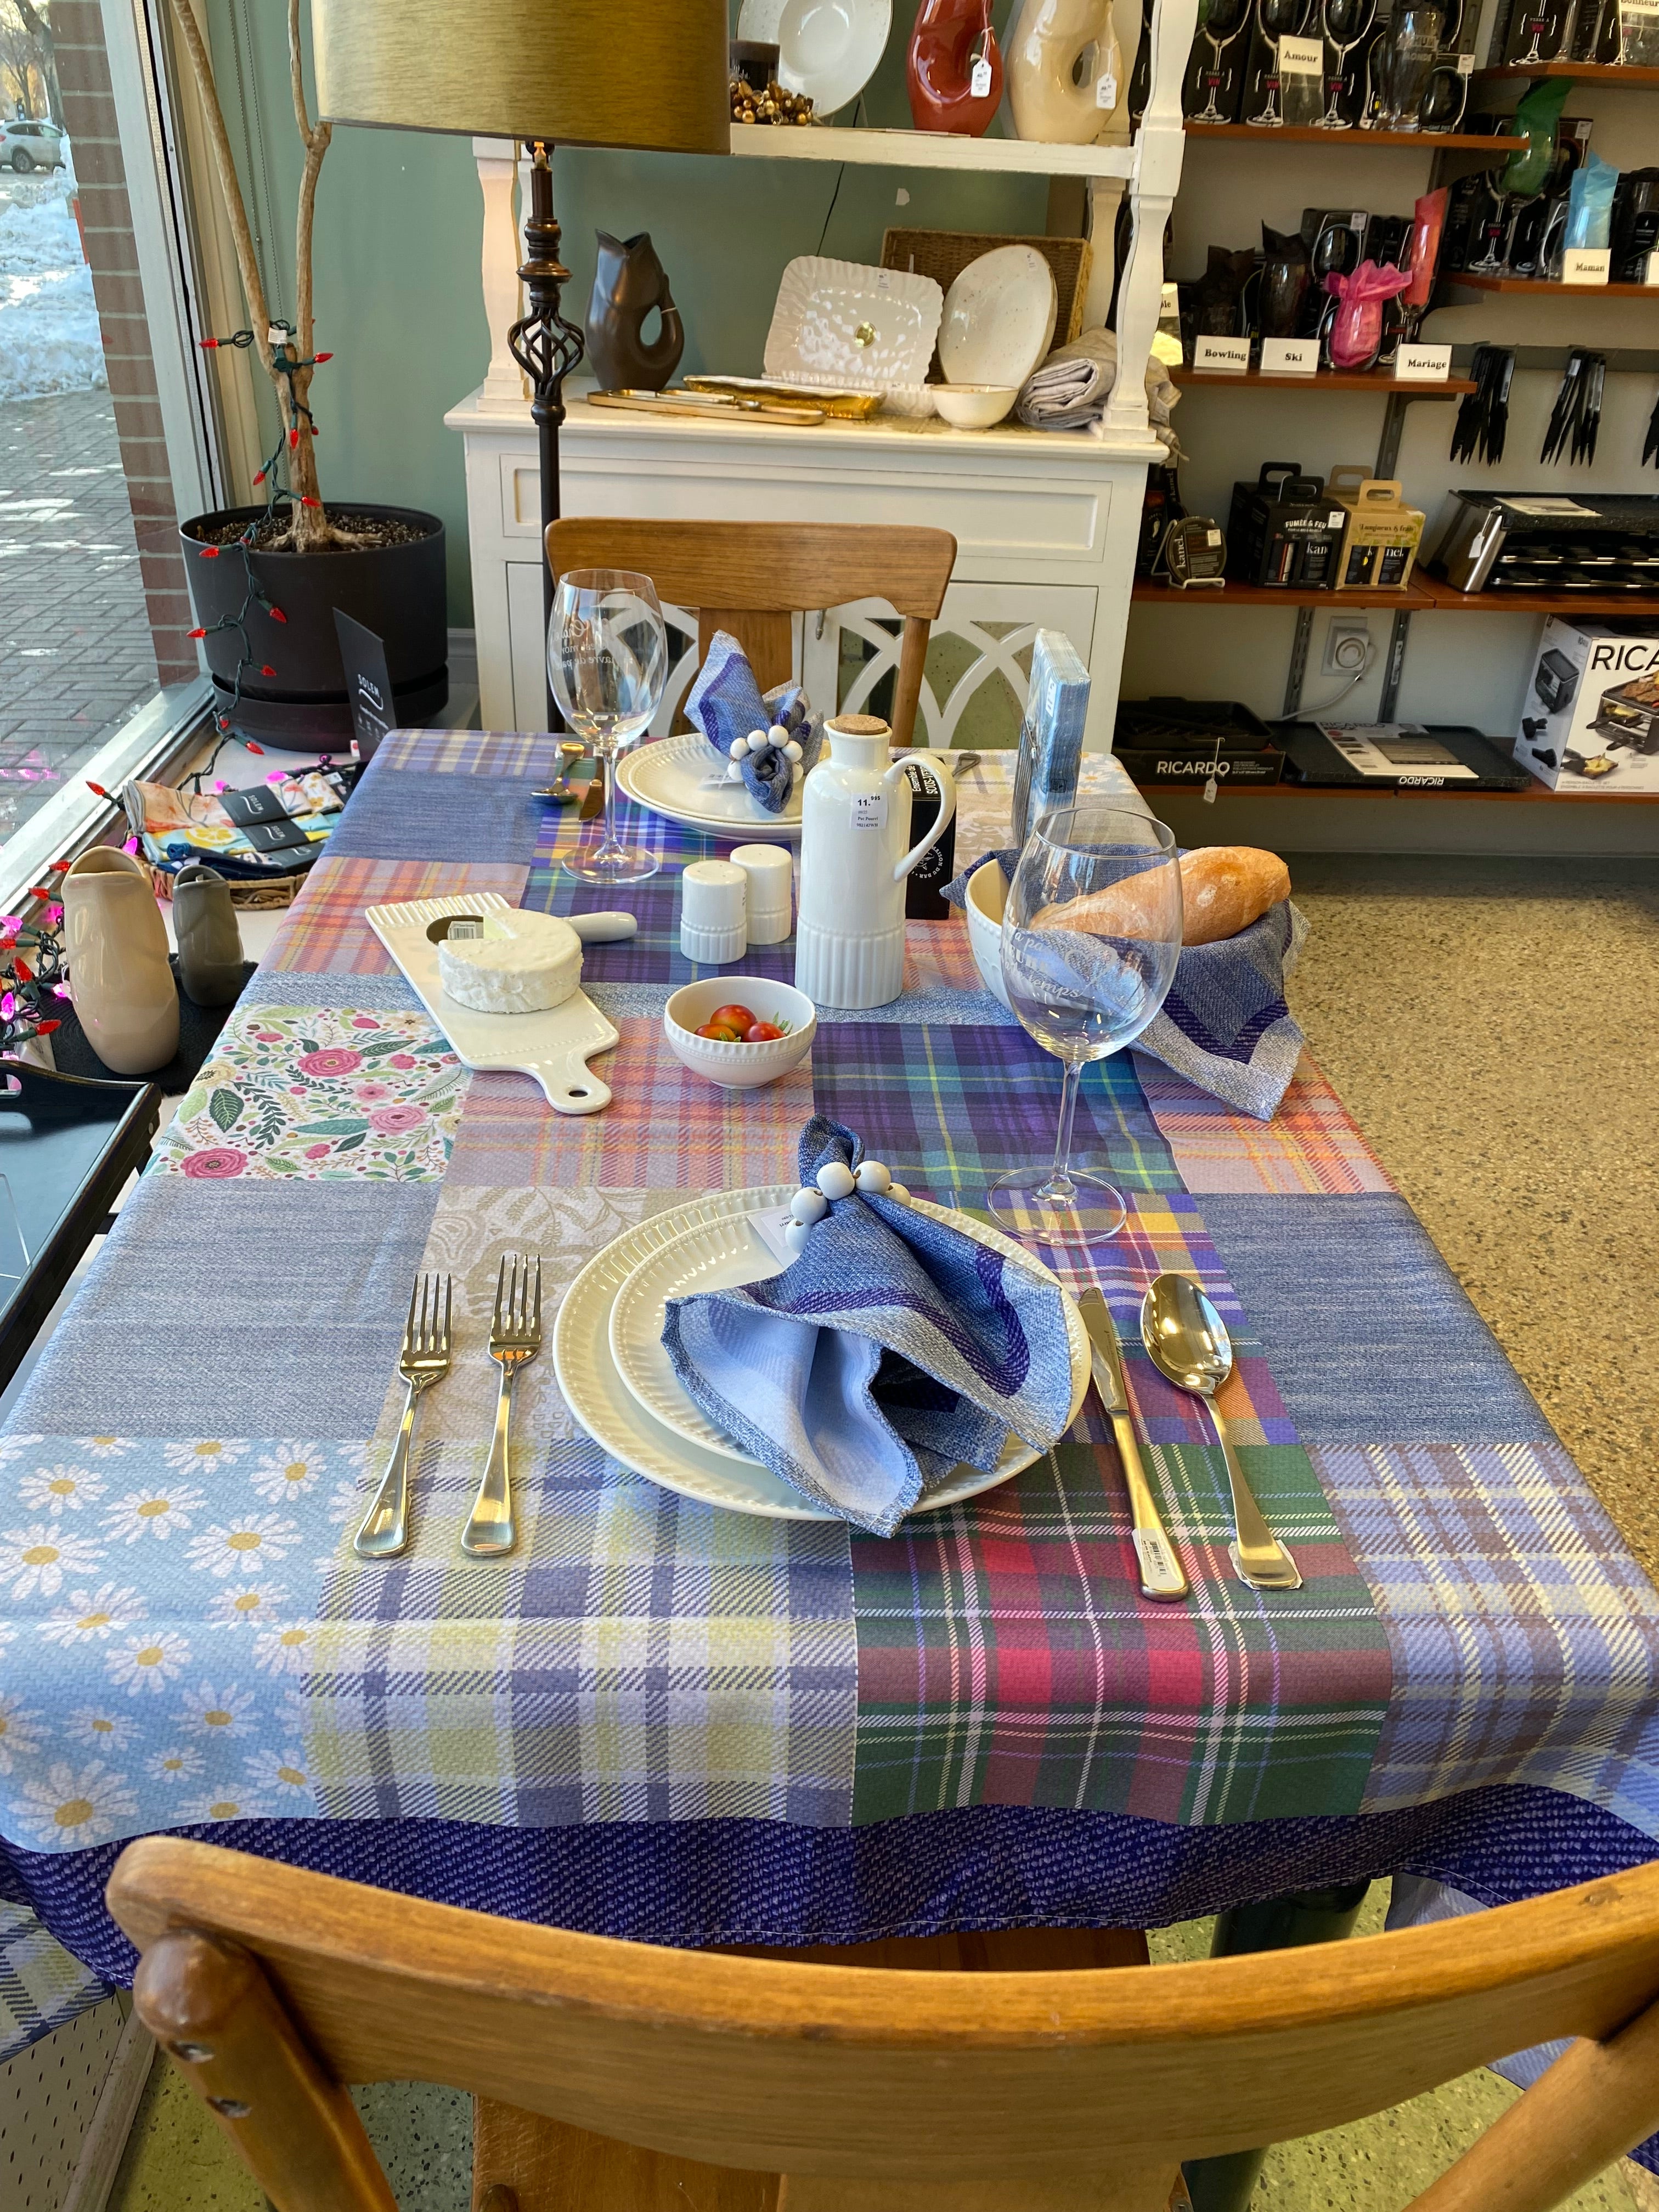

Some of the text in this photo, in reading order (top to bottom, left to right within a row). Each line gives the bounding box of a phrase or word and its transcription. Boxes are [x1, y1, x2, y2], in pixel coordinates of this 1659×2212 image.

[1284, 50, 1318, 63] Amour
[1576, 262, 1605, 272] Maman
[1205, 348, 1246, 361] Bowling
[1285, 353, 1302, 362] Ski
[1408, 359, 1447, 369] Mariage
[1314, 521, 1327, 529] FEU
[1156, 760, 1231, 775] RICARDO
[1399, 776, 1444, 786] RICARDO
